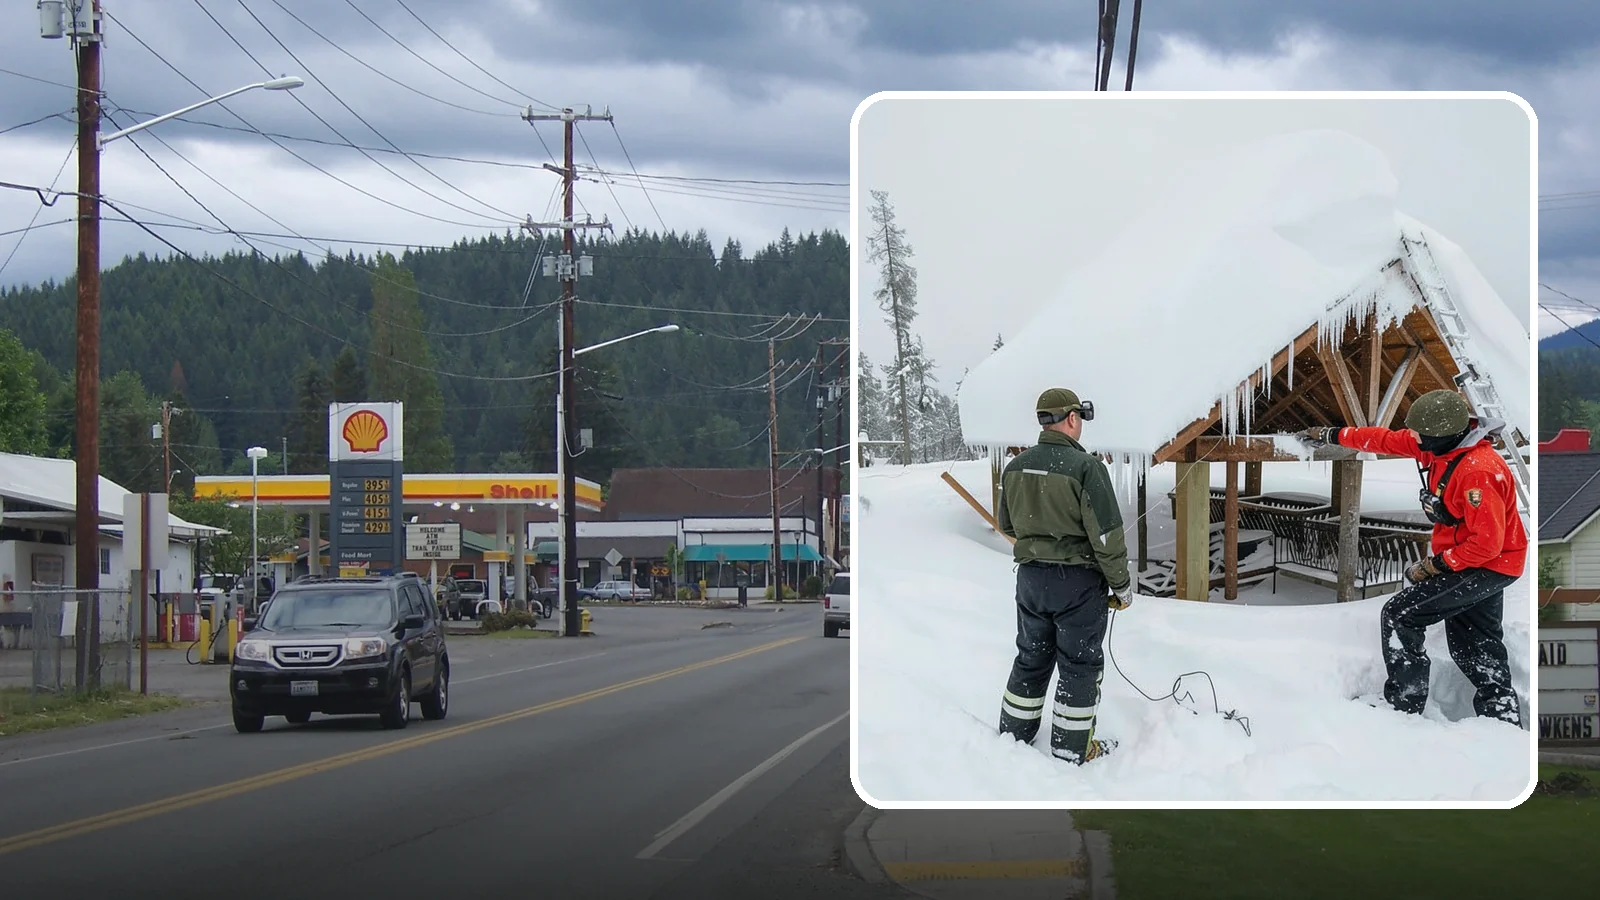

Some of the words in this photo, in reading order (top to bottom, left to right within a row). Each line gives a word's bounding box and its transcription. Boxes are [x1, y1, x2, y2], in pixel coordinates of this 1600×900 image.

[366, 480, 384, 490] 395
[490, 484, 547, 498] Shell
[366, 494, 383, 504] 405
[366, 508, 383, 518] 415
[366, 522, 383, 532] 429
